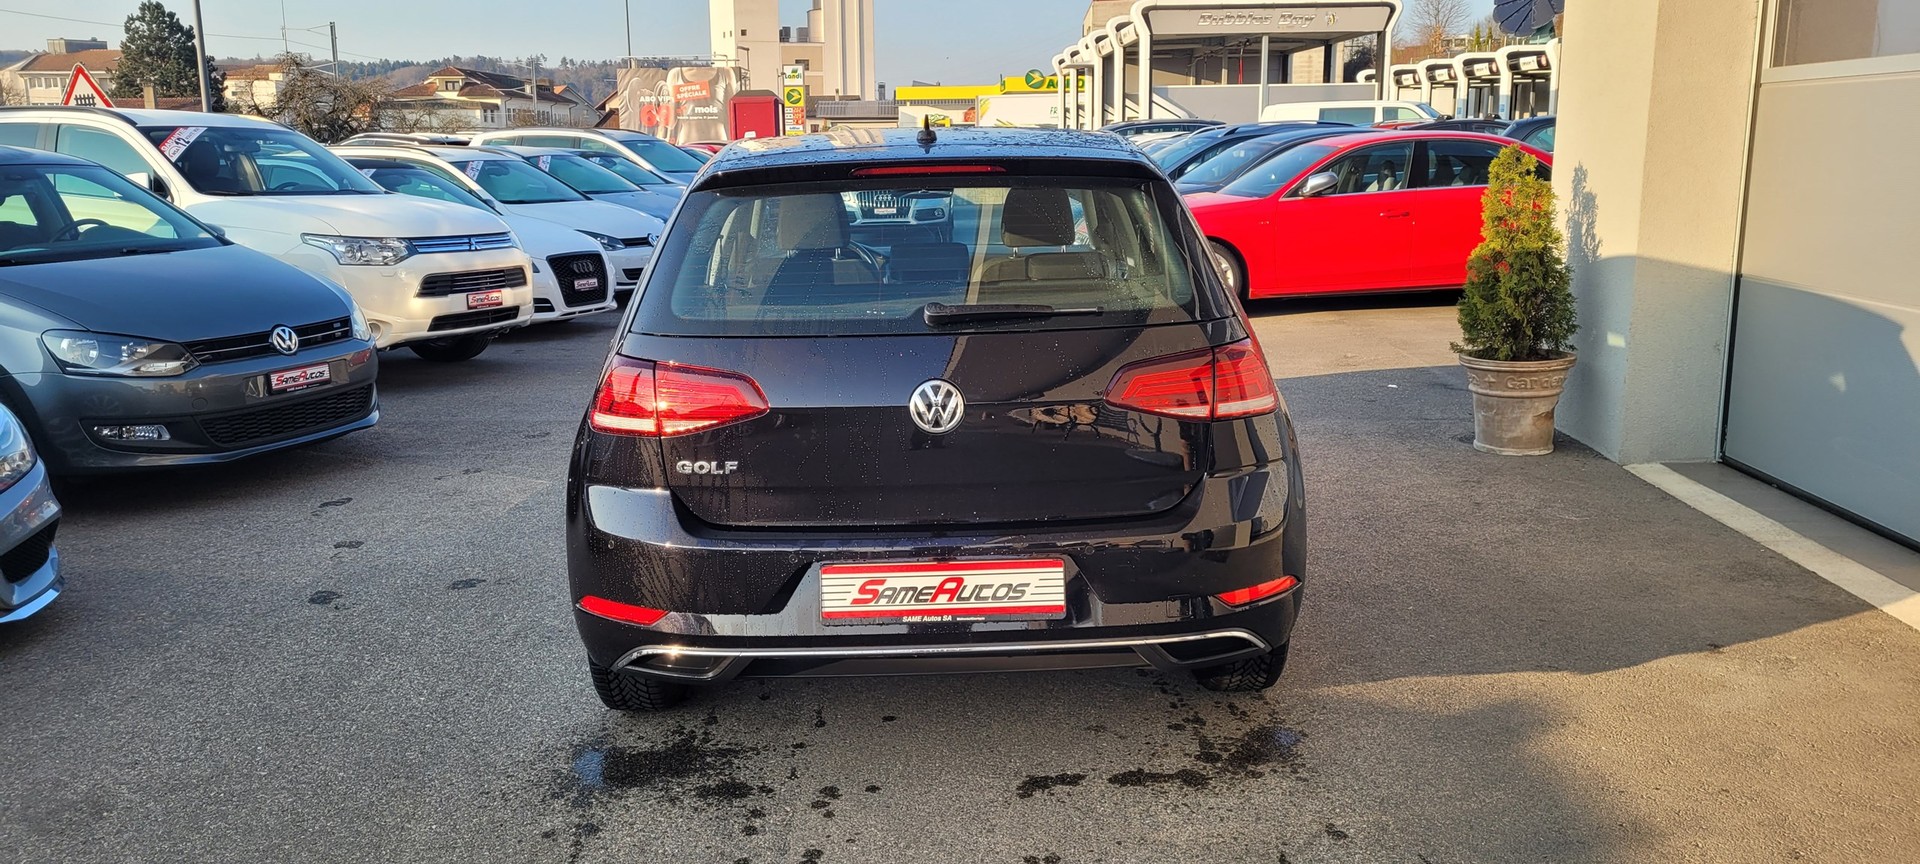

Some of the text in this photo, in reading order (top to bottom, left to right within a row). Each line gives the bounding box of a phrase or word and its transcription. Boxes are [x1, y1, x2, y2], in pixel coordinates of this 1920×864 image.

[1198, 12, 1316, 28] Bubbles Bay
[679, 84, 700, 92] OFFRE
[694, 105, 718, 114] mois
[676, 461, 738, 475] GOLF
[902, 615, 922, 623] SAME
